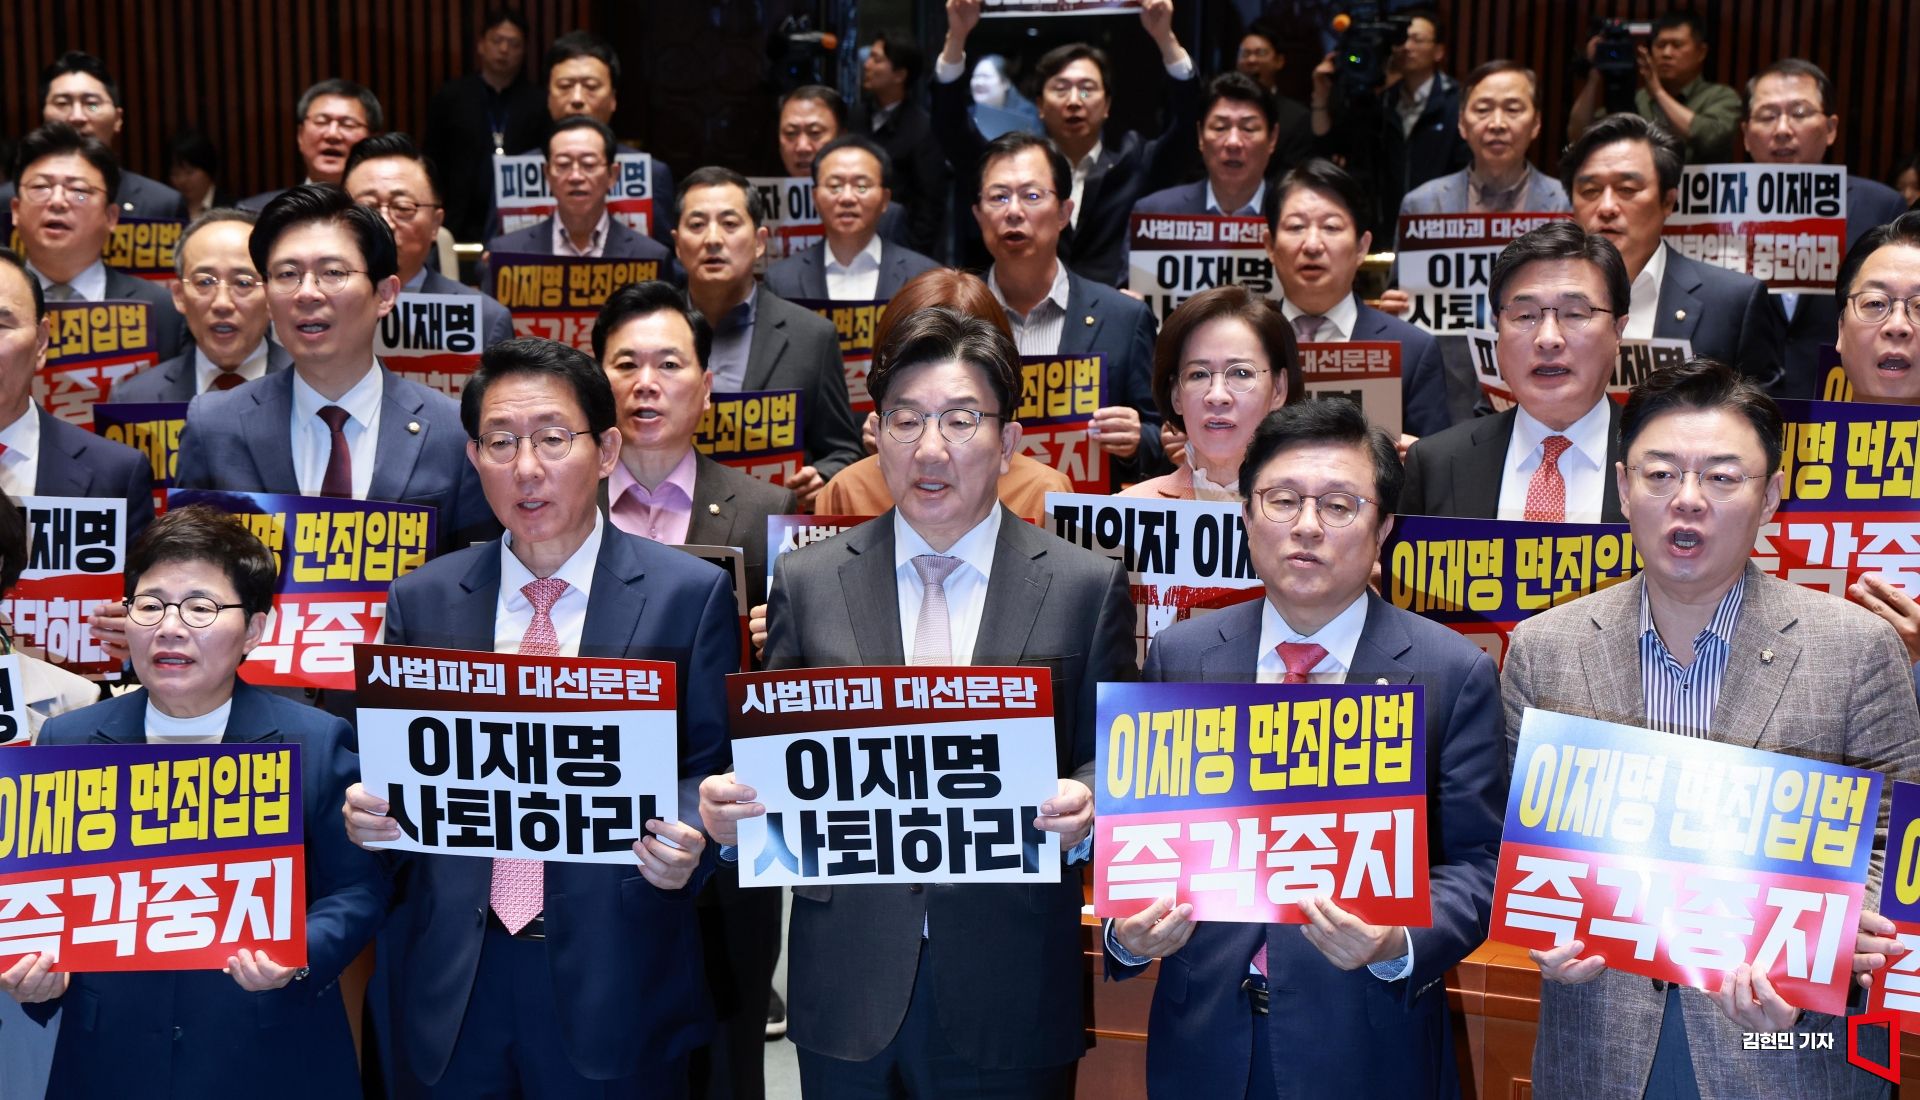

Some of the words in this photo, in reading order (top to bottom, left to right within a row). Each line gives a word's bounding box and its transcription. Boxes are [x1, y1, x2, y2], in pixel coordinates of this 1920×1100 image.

[1758, 172, 1840, 217] 이재명
[104, 223, 182, 268] 죄입법
[1137, 219, 1214, 241] 사법파괴
[1405, 218, 1486, 240] 사법파괴
[1753, 232, 1838, 281] 중단하라
[497, 265, 564, 308] 이재명
[1157, 254, 1273, 294] 이재명
[382, 301, 475, 353] 이재명
[1012, 357, 1100, 420] 죄입법
[1298, 349, 1392, 373] 대선문란
[17, 507, 116, 573] 재명
[292, 511, 428, 583] 면죄입법
[1391, 539, 1504, 612] 이재명
[1515, 533, 1643, 610] 면죄입
[368, 655, 505, 696] 사법파괴
[517, 661, 661, 702] 대선문란
[741, 680, 883, 717] 사법파괴
[895, 674, 1037, 711] 대선문란
[408, 716, 622, 788] 이재명
[785, 733, 1002, 801] 이재명
[1107, 704, 1236, 799] 이재명
[1248, 691, 1415, 793] 면죄입법
[0, 765, 118, 859] 이재명
[130, 750, 291, 847] 면죄입법
[388, 784, 664, 855] 사퇴하라
[1518, 743, 1667, 843] 이재명
[1669, 758, 1870, 868] 면죄입법
[754, 806, 1046, 878] 사퇴하라
[1107, 810, 1415, 905] 즉각중지
[0, 857, 293, 964] 즉각중지
[1504, 855, 1849, 985] 즉각중지
